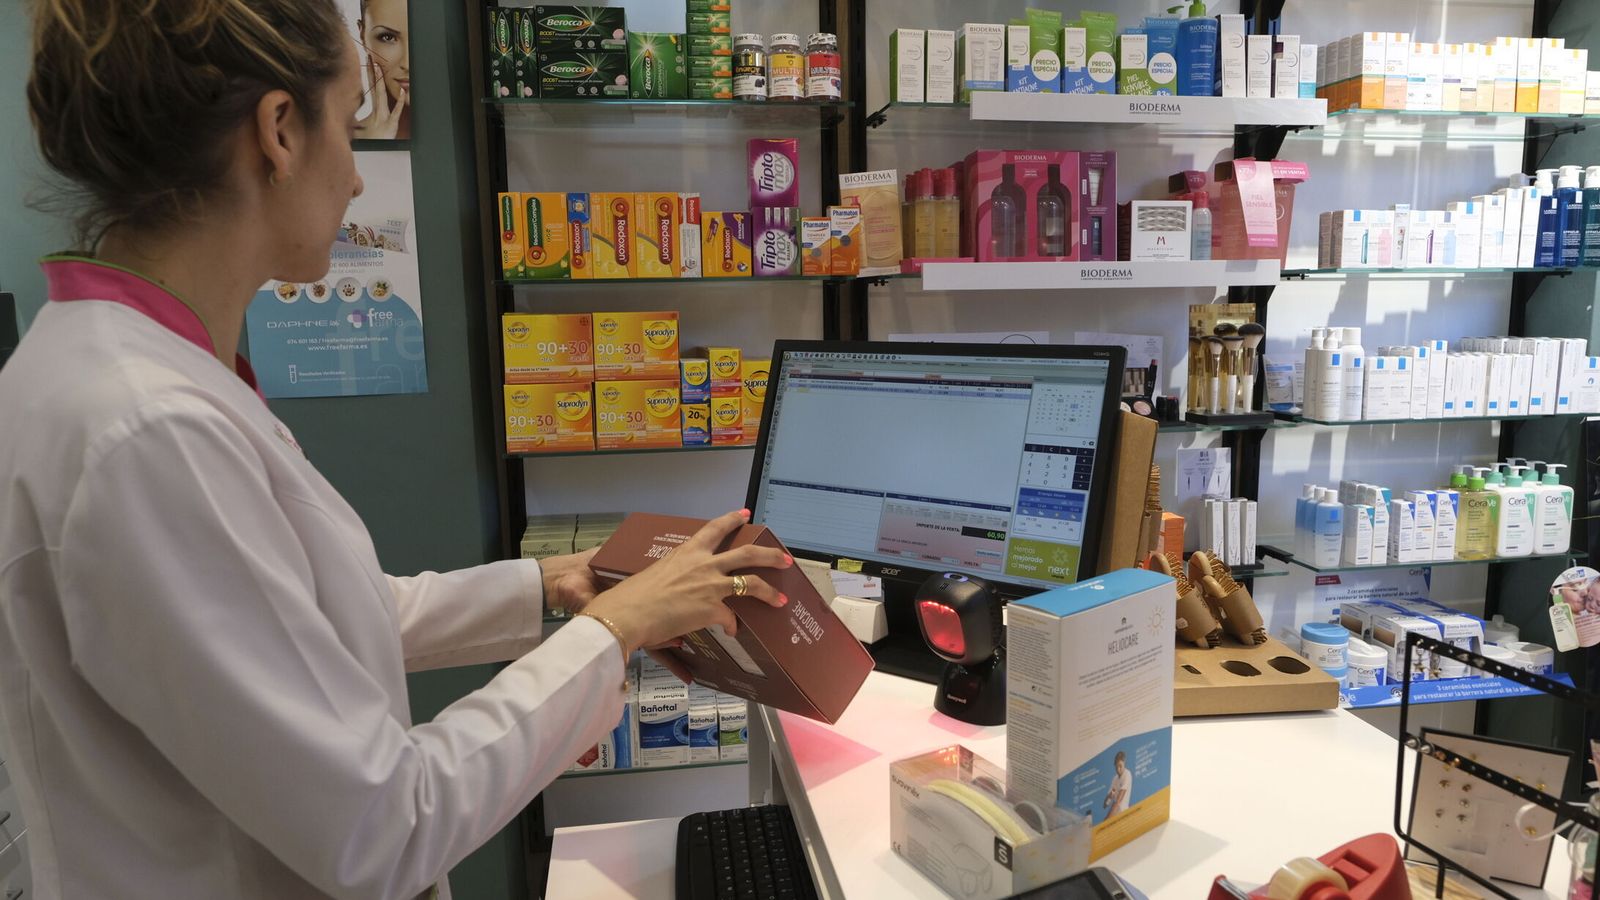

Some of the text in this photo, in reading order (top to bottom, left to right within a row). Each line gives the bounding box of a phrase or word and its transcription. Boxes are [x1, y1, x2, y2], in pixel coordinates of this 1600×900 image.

[546, 18, 583, 26] Berocca
[1129, 103, 1181, 112] BIODERMA
[758, 153, 773, 192] Tripto
[774, 154, 785, 190] max
[844, 172, 893, 184] BIODERMA
[832, 209, 859, 217] Pharmaton
[803, 221, 830, 229] Pharmaton
[574, 222, 582, 254] Redoxon
[618, 219, 627, 260] Redoxon
[661, 219, 670, 260] Redoxon
[761, 231, 776, 269] Tripto
[776, 232, 787, 267] max
[1080, 268, 1133, 278] BIODERMA
[267, 320, 328, 328] DAPHNE
[644, 328, 675, 338] Supradyn
[537, 340, 588, 356] 90+30
[597, 342, 641, 355] 90+30
[557, 399, 588, 409] Supradyn
[647, 397, 677, 407] Supradyn
[599, 410, 643, 424] 90+30
[688, 410, 706, 420] 20%
[508, 414, 554, 428] 90+30
[1468, 499, 1497, 508] CeraVe
[987, 531, 1005, 540] 60,90
[1012, 554, 1044, 564] mejorado
[881, 567, 900, 576] acer
[1018, 563, 1037, 572] mejor
[1047, 565, 1071, 576] next
[792, 600, 824, 641] ENDOCARE
[1107, 632, 1140, 656] HELIOCARE
[1441, 683, 1471, 691] ceramidas
[1472, 681, 1501, 689] esenciales
[1427, 692, 1455, 700] restaurar
[1484, 688, 1504, 696] natural
[641, 703, 677, 713] Bañoftal
[721, 714, 746, 722] Bañoftal
[892, 774, 920, 799] suavinex
